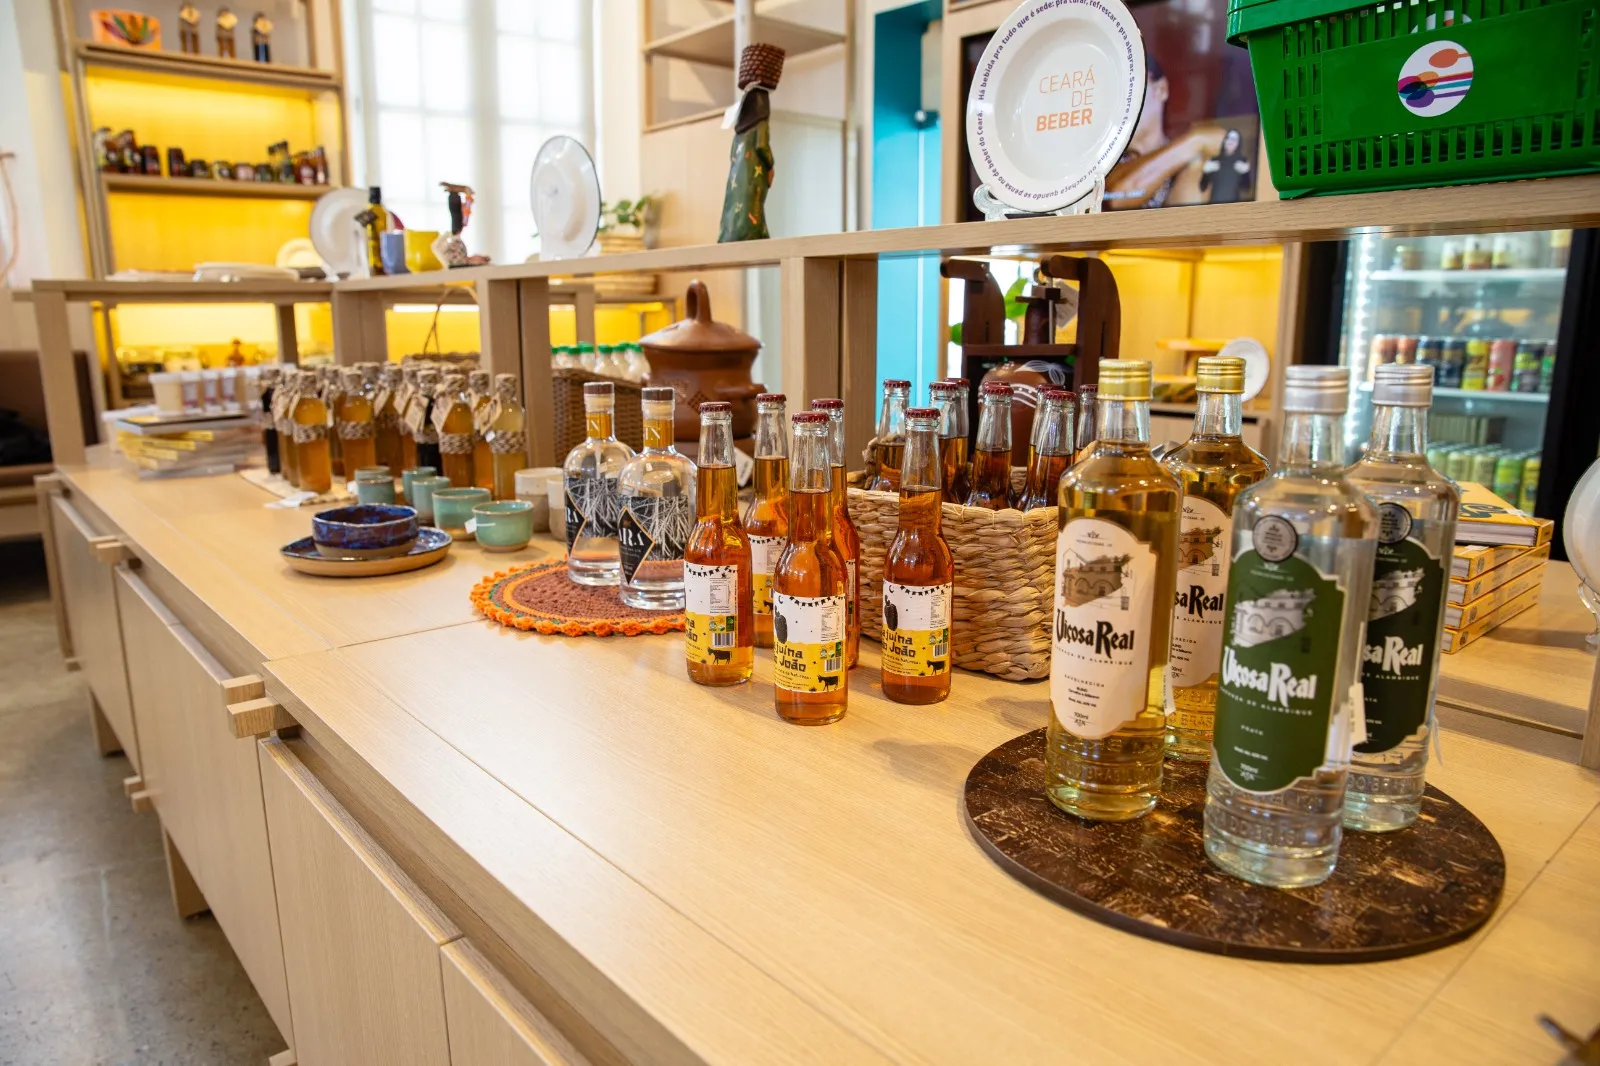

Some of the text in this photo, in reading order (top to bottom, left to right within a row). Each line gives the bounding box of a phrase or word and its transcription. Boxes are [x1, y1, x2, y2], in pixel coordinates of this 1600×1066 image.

[1036, 1, 1055, 14] sede:
[1056, 0, 1068, 8] pra
[1089, 1, 1117, 22] refrescar
[1017, 15, 1030, 30] que
[1030, 10, 1035, 18] é
[1002, 27, 1017, 44] tudo
[1119, 26, 1128, 40] pra
[994, 45, 1004, 60] pra
[1126, 41, 1134, 75] alegrar.
[980, 59, 996, 87] bebida
[1039, 64, 1096, 94] CEARÁ
[978, 89, 986, 100] Há
[1071, 88, 1094, 108] DE
[1125, 76, 1135, 114] Sempre
[1036, 108, 1092, 132] BEBER
[1117, 116, 1128, 135] tem
[978, 136, 986, 146] do
[982, 148, 994, 170] beber
[1098, 137, 1118, 164] cajuína
[992, 168, 1000, 177] de
[1088, 165, 1097, 176] ou
[998, 176, 1006, 184] no
[1060, 175, 1088, 195] cachaça
[1005, 183, 1024, 196] pensa
[1033, 190, 1059, 200] quando
[1188, 584, 1224, 619] Real
[1056, 608, 1134, 660] Viçosa Real
[890, 642, 916, 658] João
[1382, 636, 1424, 676] Real
[780, 655, 806, 672] João
[1222, 646, 1318, 708] Viçosa Real
